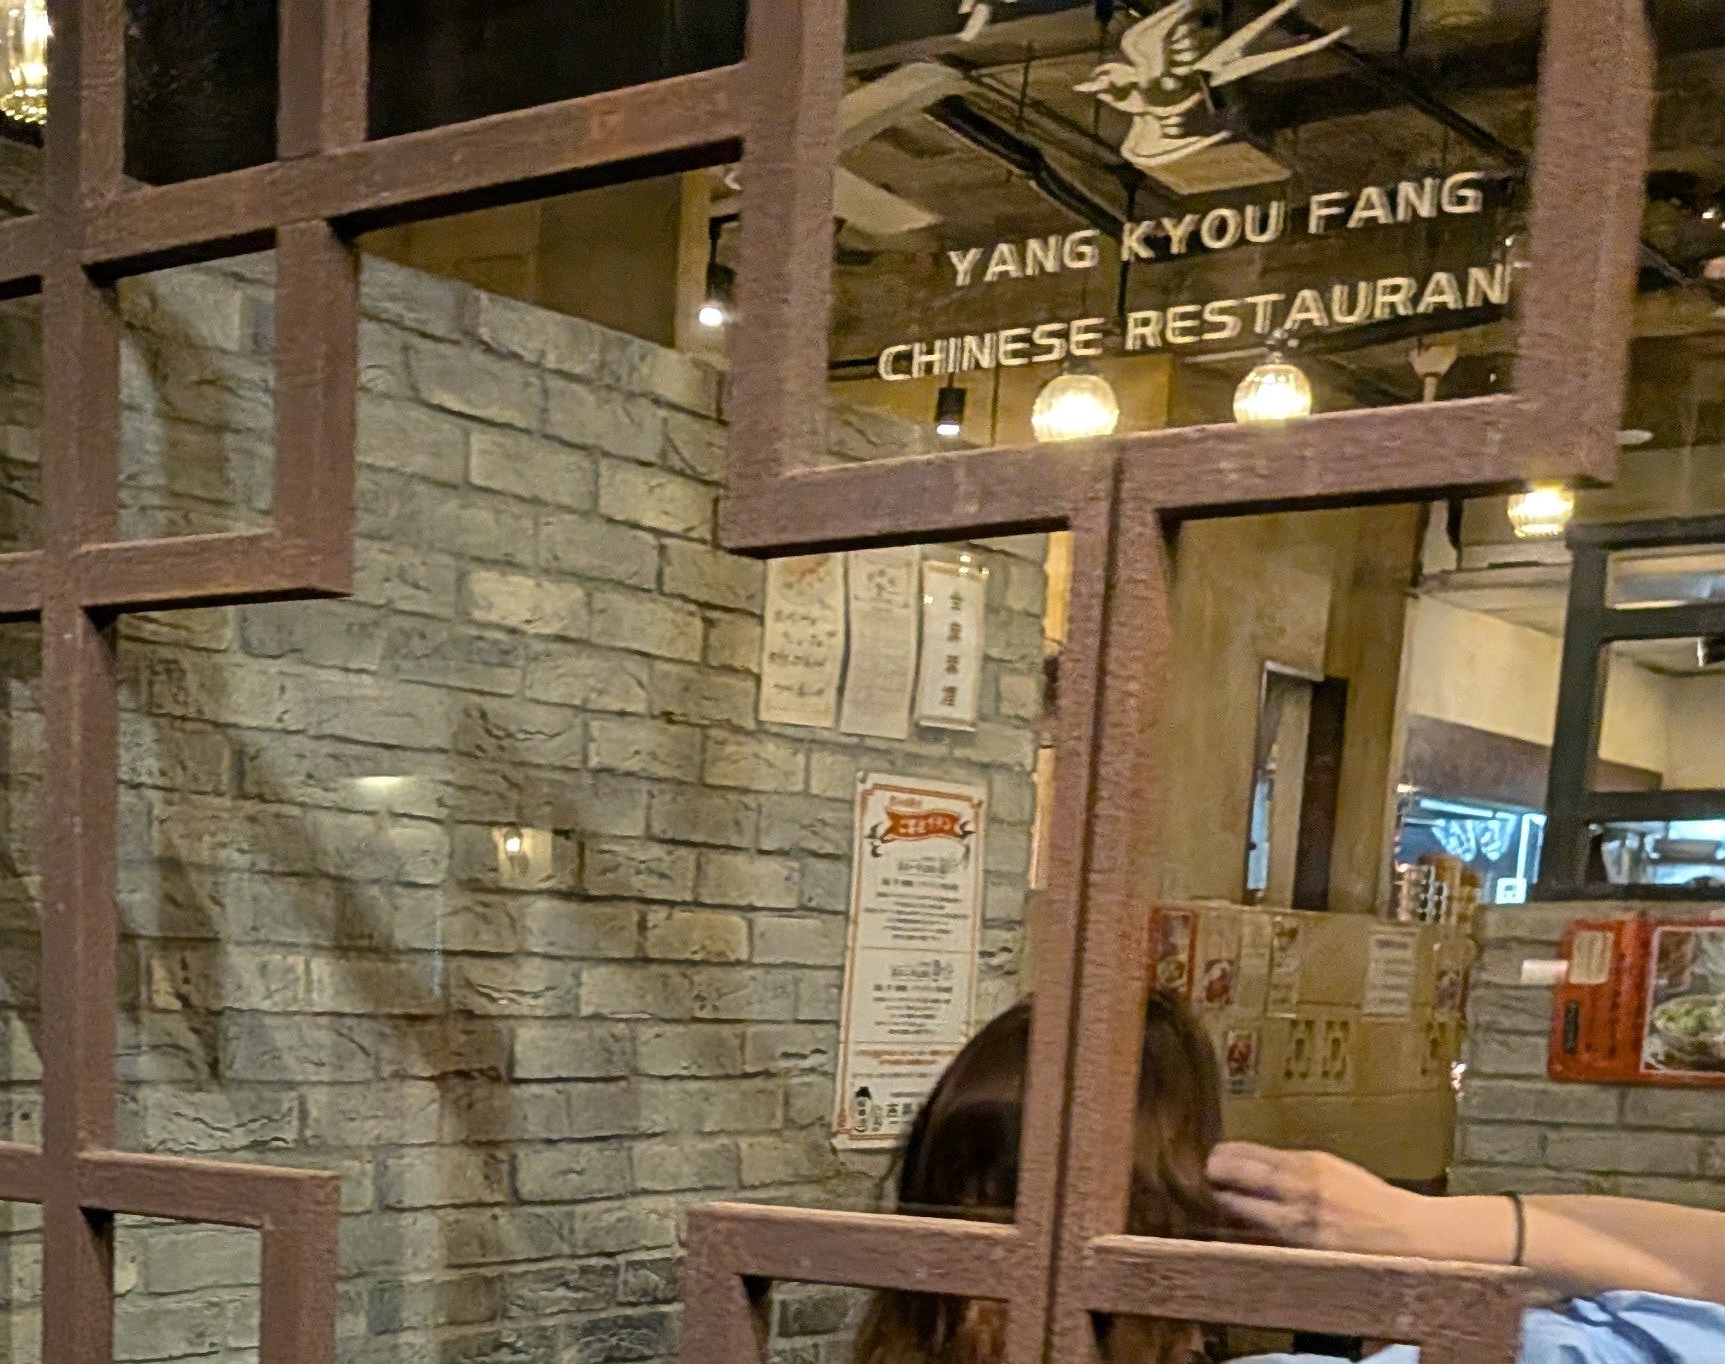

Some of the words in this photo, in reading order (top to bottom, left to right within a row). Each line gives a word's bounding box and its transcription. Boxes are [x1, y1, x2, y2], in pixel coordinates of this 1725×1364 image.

[948, 228, 1100, 288] YANG
[1120, 200, 1286, 262] KYOU
[1308, 171, 1486, 235] FANG
[878, 316, 1106, 382] CHINESE
[1125, 262, 1530, 351] RESTAURAN
